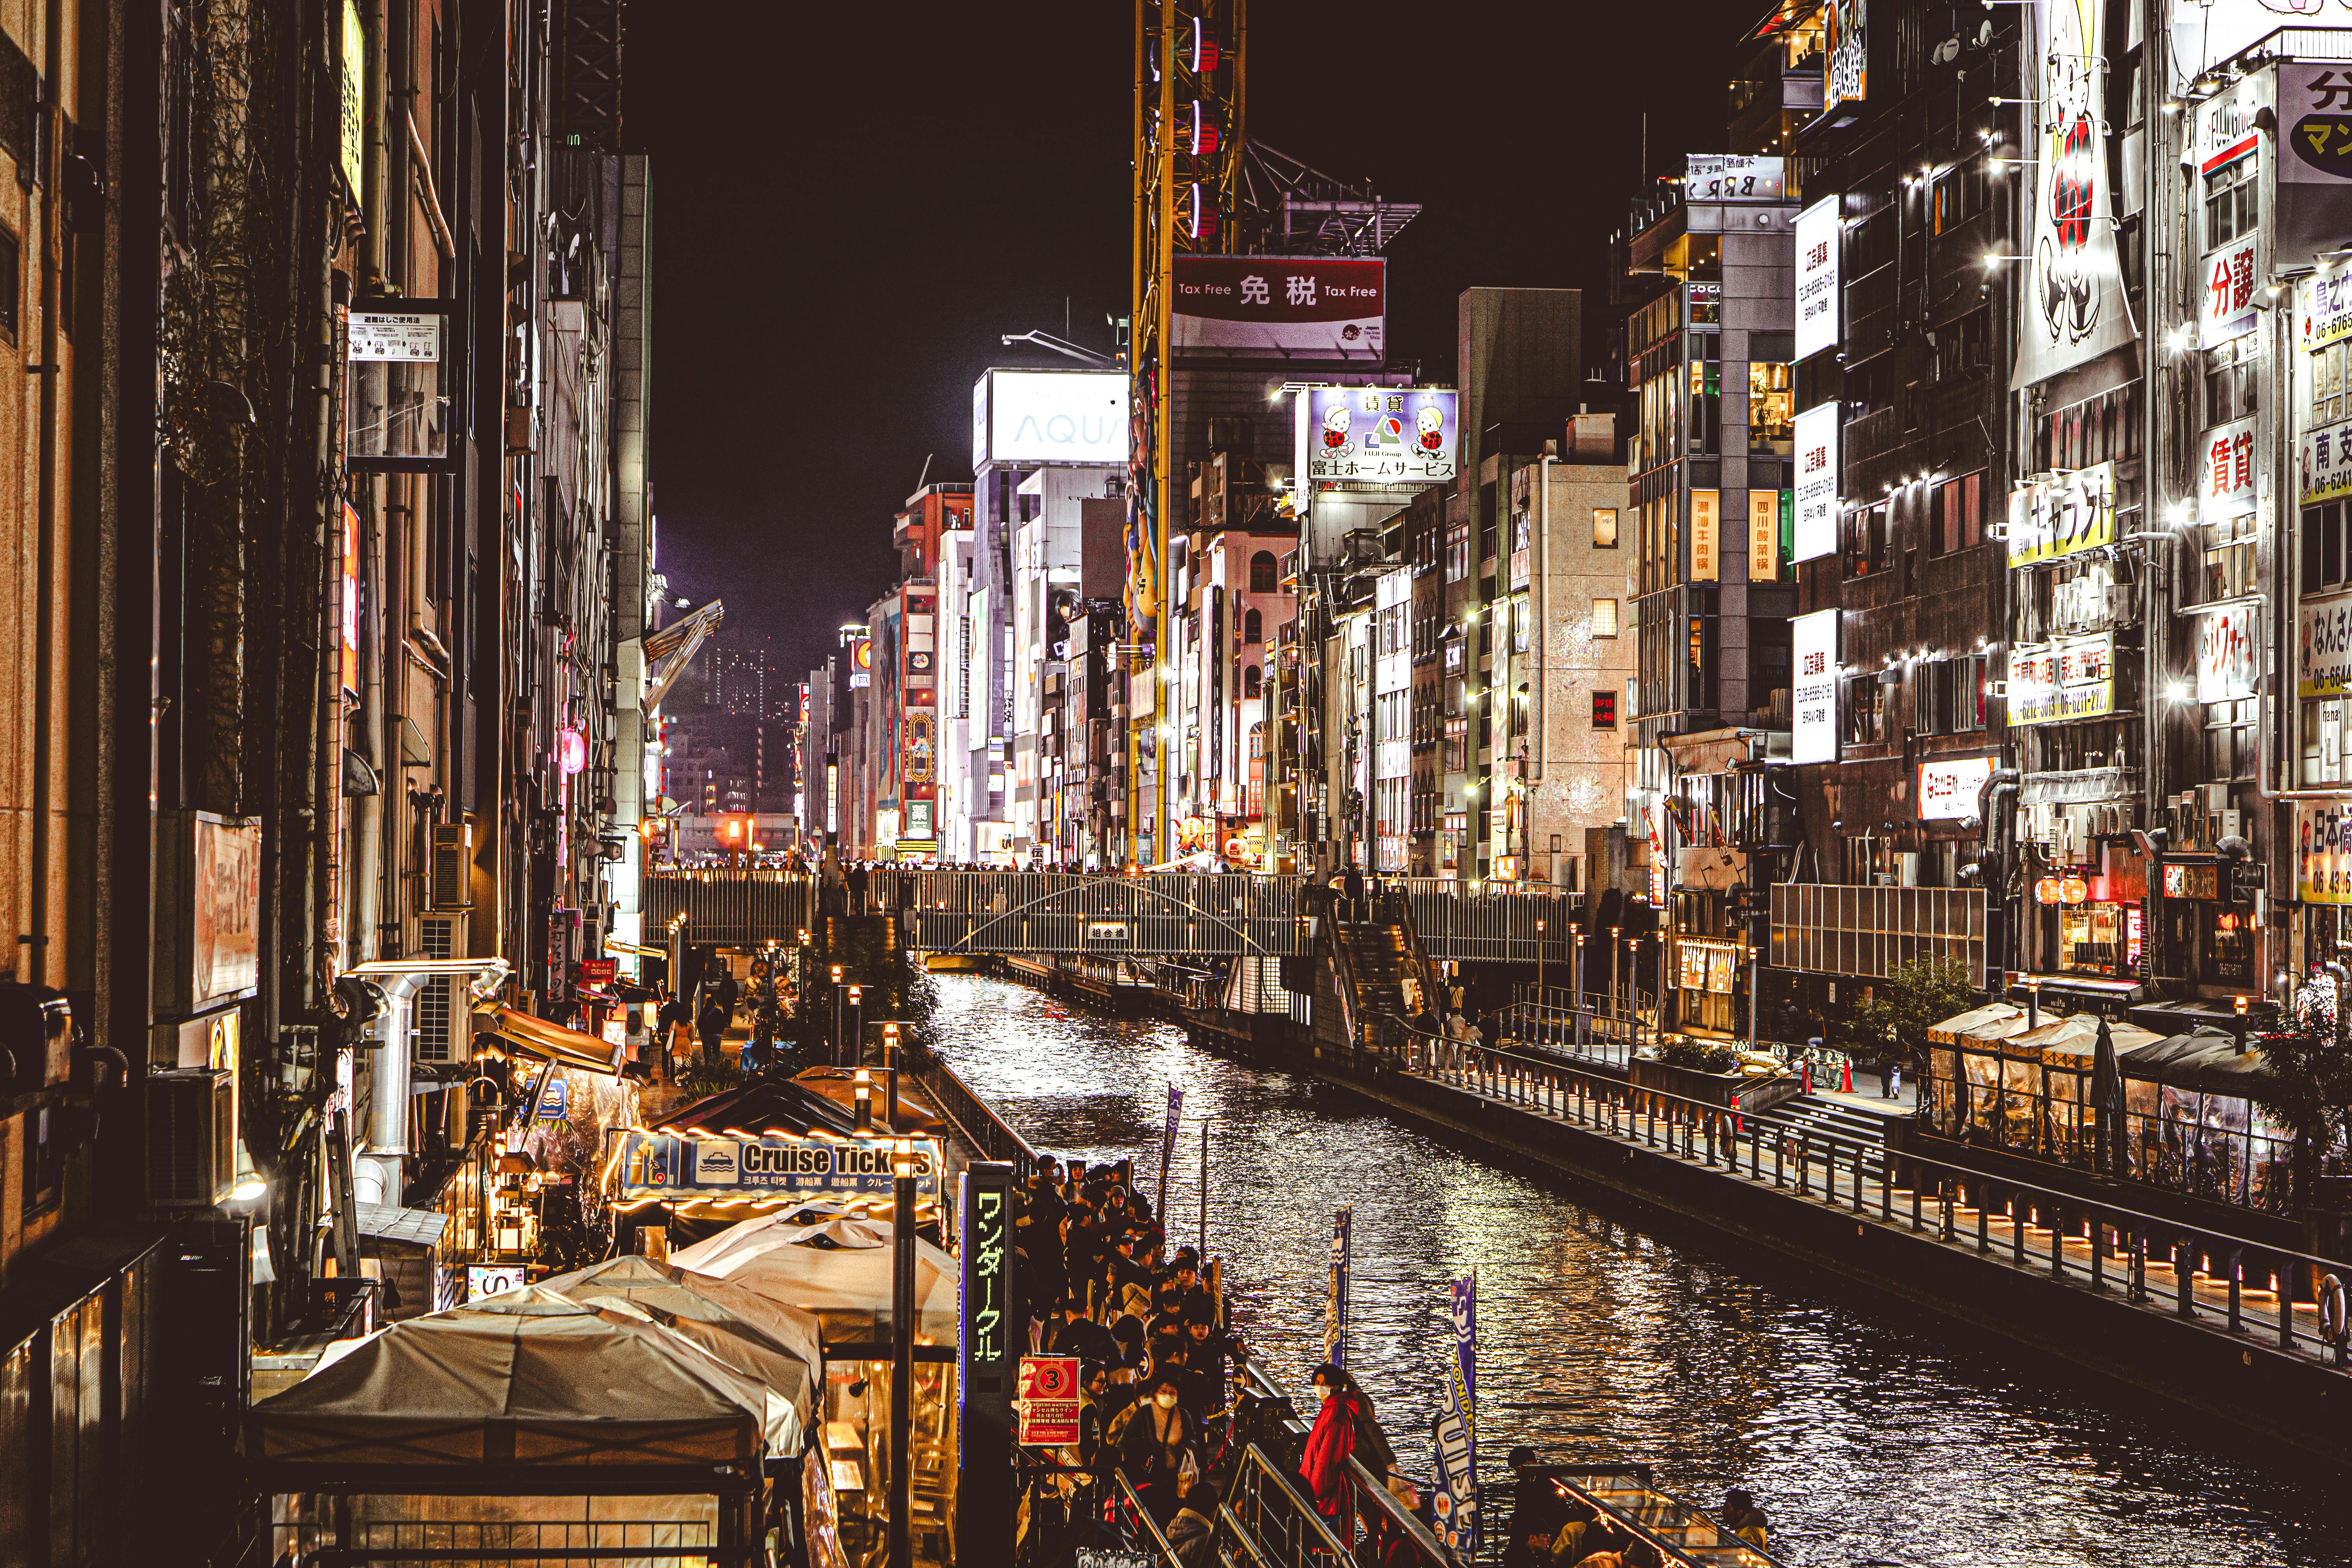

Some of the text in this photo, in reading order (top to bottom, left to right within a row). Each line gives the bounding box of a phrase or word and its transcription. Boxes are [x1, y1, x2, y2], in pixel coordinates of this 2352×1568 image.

[2212, 98, 2256, 150] FUJI Group
[1806, 241, 1827, 272] 広告募集
[1179, 283, 1231, 295] Tax Free
[1240, 275, 1317, 305] 免税
[1325, 286, 1377, 297] Tax Free
[2211, 247, 2254, 318] 分譲
[364, 316, 420, 324] 避難はしご使用法
[1805, 303, 1818, 321] BRAVI
[1365, 395, 1404, 412] 賃貸
[1312, 460, 1454, 476] 富士ホームサービス
[1805, 446, 1826, 474] 広告募集
[2211, 430, 2253, 497] 賃貸
[2315, 469, 2352, 495] 06-6241
[1804, 506, 1816, 522] BRAVI
[1697, 501, 1709, 570] 潮汕牛肉锅
[1757, 501, 1769, 570] 四川酸菜锅
[2211, 609, 2253, 677] リフォーム
[1804, 651, 1824, 676] 広告募集
[1803, 710, 1815, 724] BRAVI
[1092, 928, 1124, 938] 相合橋
[744, 1143, 933, 1175] Cruise Ticks
[743, 1176, 768, 1186] 크루즈
[771, 1176, 787, 1186] 티켓
[1044, 1370, 1060, 1390] 3
